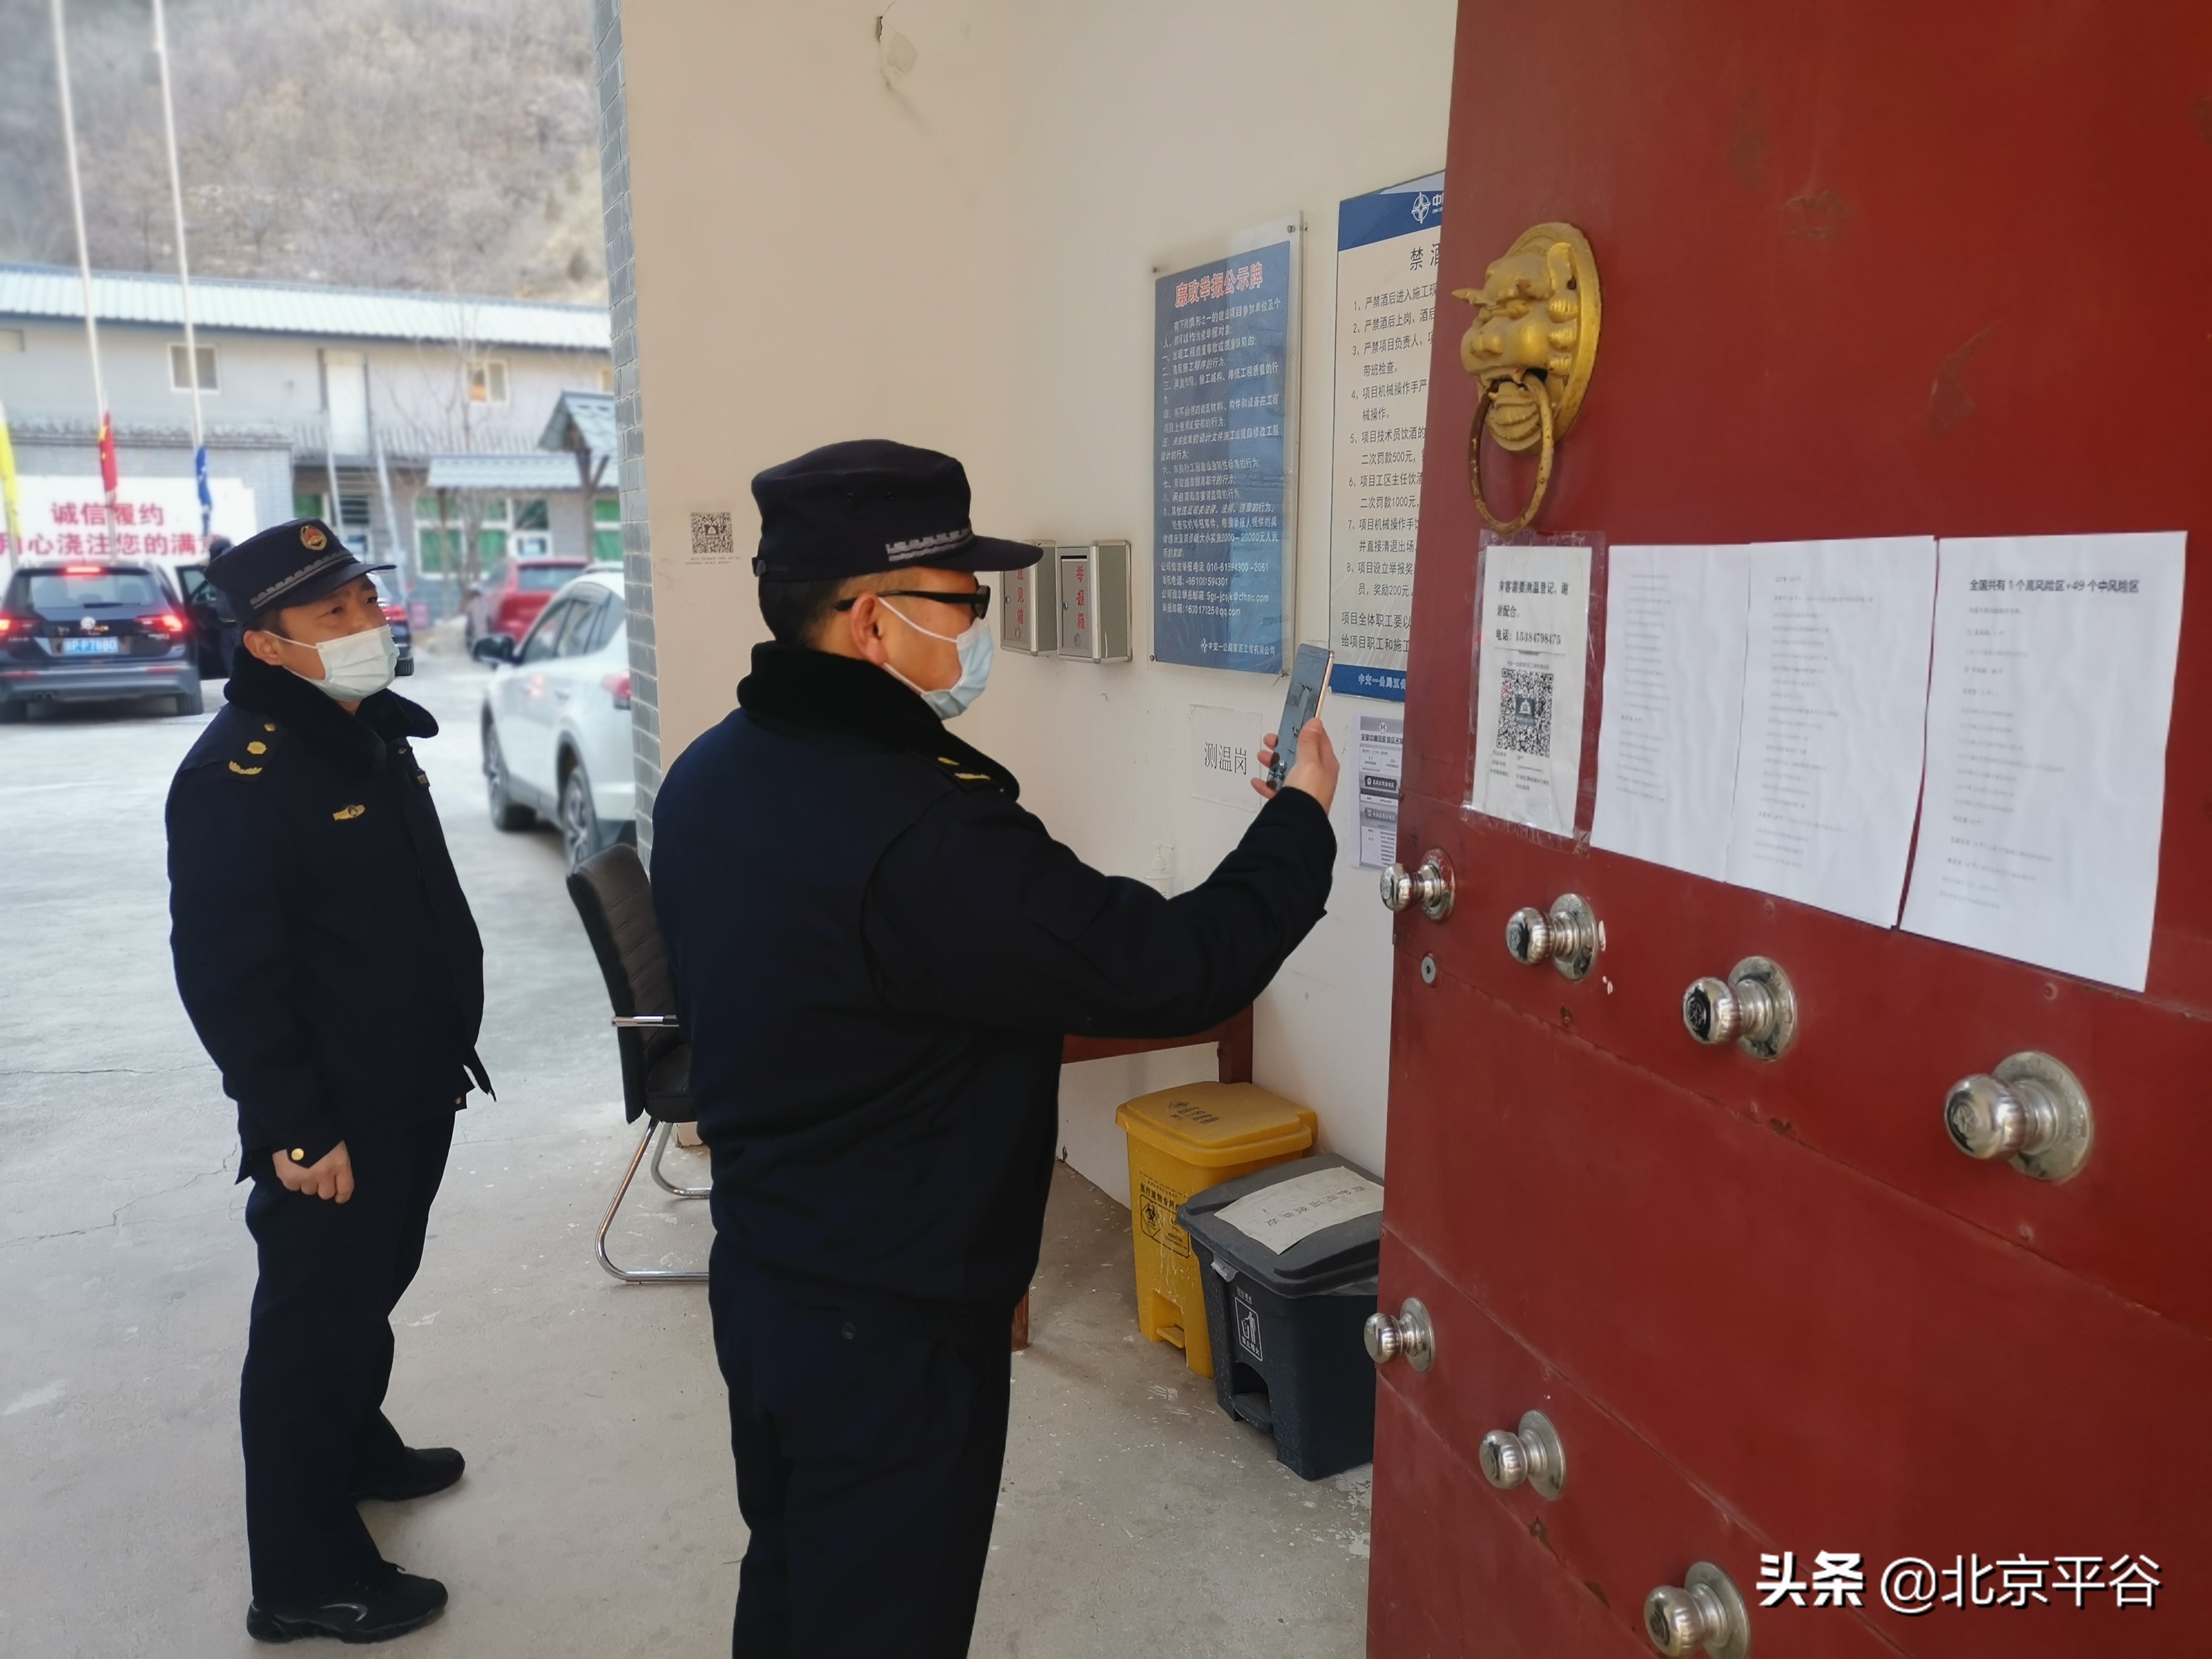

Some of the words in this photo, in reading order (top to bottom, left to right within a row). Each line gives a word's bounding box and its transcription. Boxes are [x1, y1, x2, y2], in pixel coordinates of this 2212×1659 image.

[1432, 193, 1444, 206] 中
[1175, 261, 1263, 308] 廉政举报公示牌
[1363, 361, 1398, 377] 带班检查。
[1351, 379, 1429, 400] 4、项目机械操作手严
[1362, 406, 1390, 422] 械操作。
[1361, 449, 1424, 465] 二次罚款500元，
[0, 532, 214, 556] 用心浇注您的满
[1359, 539, 1417, 553] 并直接清退出场
[1204, 741, 1248, 776] 测温岗
